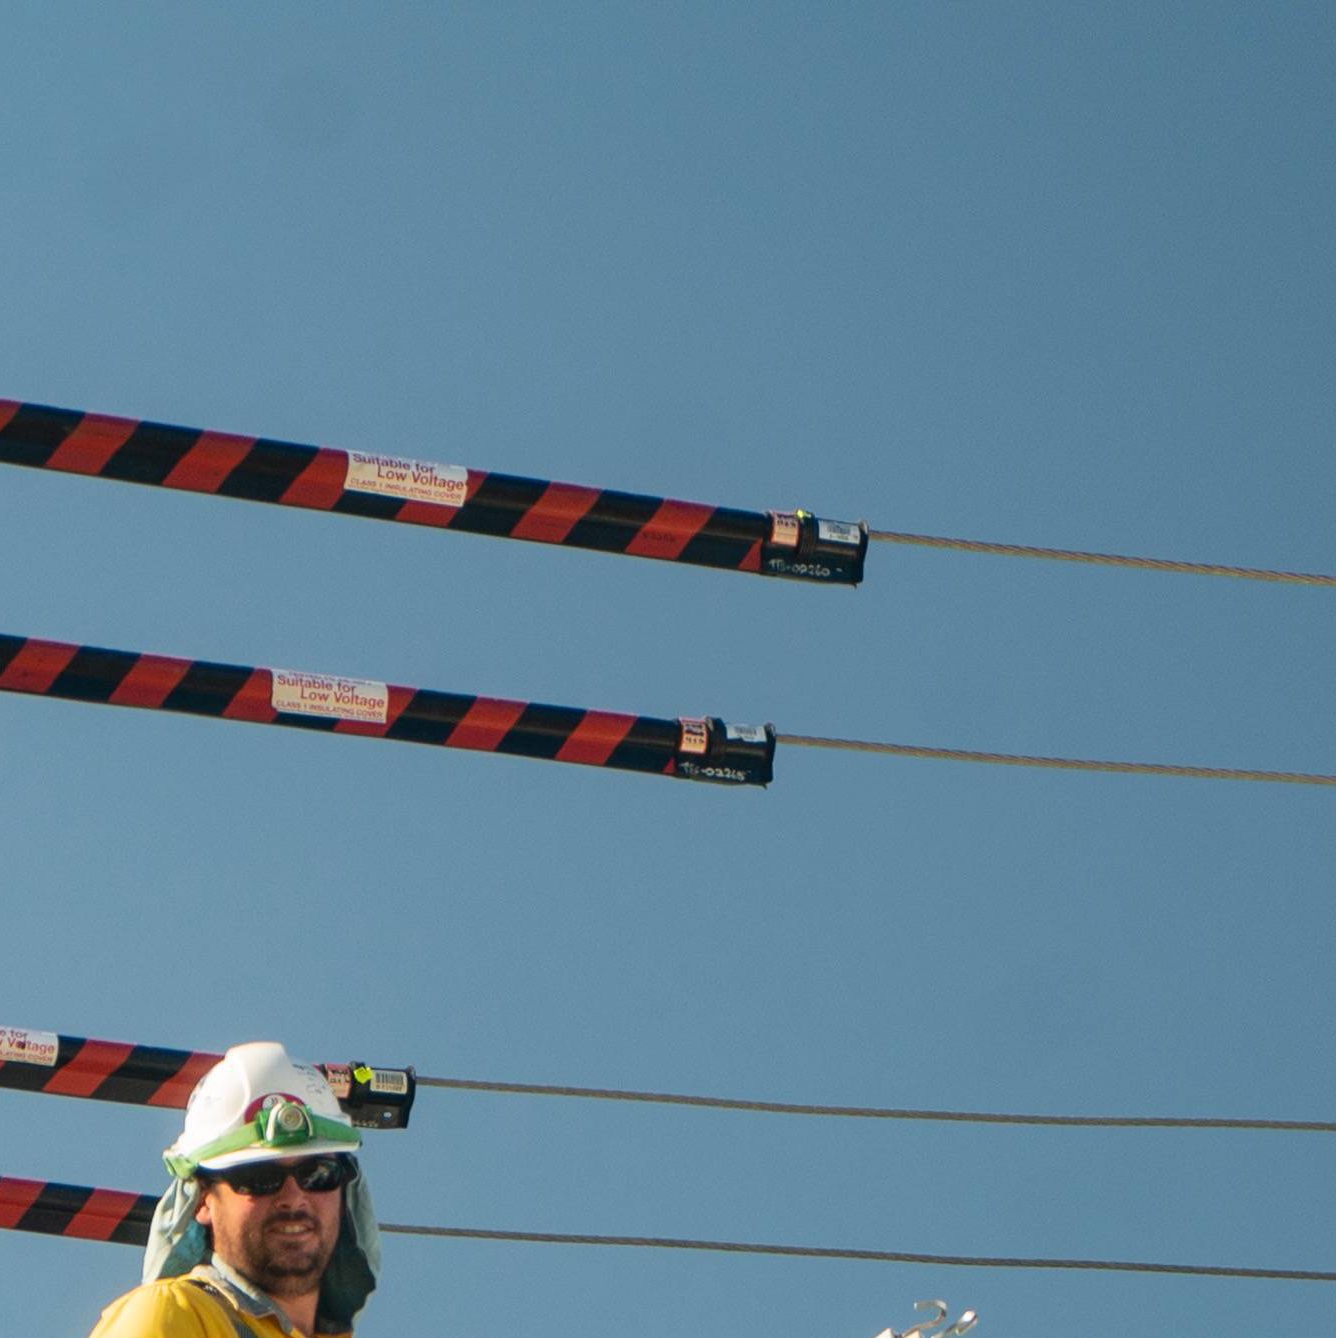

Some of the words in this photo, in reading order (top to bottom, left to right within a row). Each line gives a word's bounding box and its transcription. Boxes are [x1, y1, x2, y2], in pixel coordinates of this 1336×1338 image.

[352, 453, 411, 470] Suitable
[415, 462, 436, 474] for
[376, 465, 407, 481] Low
[410, 470, 465, 491] Voltage
[277, 673, 333, 692] Suitable
[336, 681, 357, 694] for
[300, 687, 330, 701] Low
[332, 690, 385, 710] Voltage
[10, 1029, 29, 1040] for
